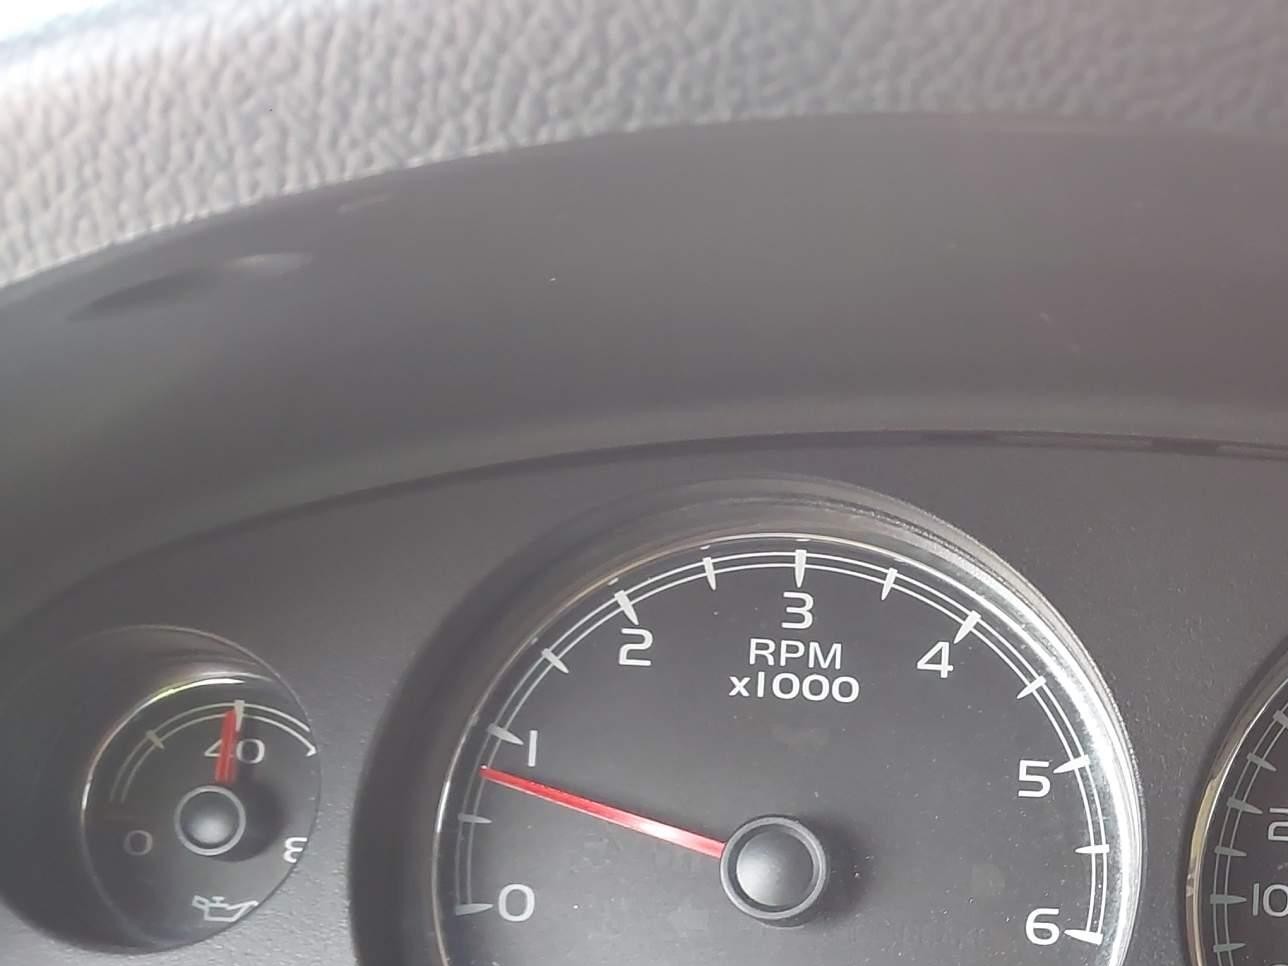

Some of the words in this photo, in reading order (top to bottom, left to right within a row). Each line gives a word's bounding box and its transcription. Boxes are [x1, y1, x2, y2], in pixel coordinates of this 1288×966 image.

[782, 592, 814, 630] 3
[618, 629, 654, 666] 2
[748, 639, 843, 670] RPM
[917, 642, 954, 678] 4
[528, 729, 537, 767] 1
[1017, 760, 1052, 798] 5
[499, 884, 535, 921] 0
[1025, 908, 1061, 945] 6
